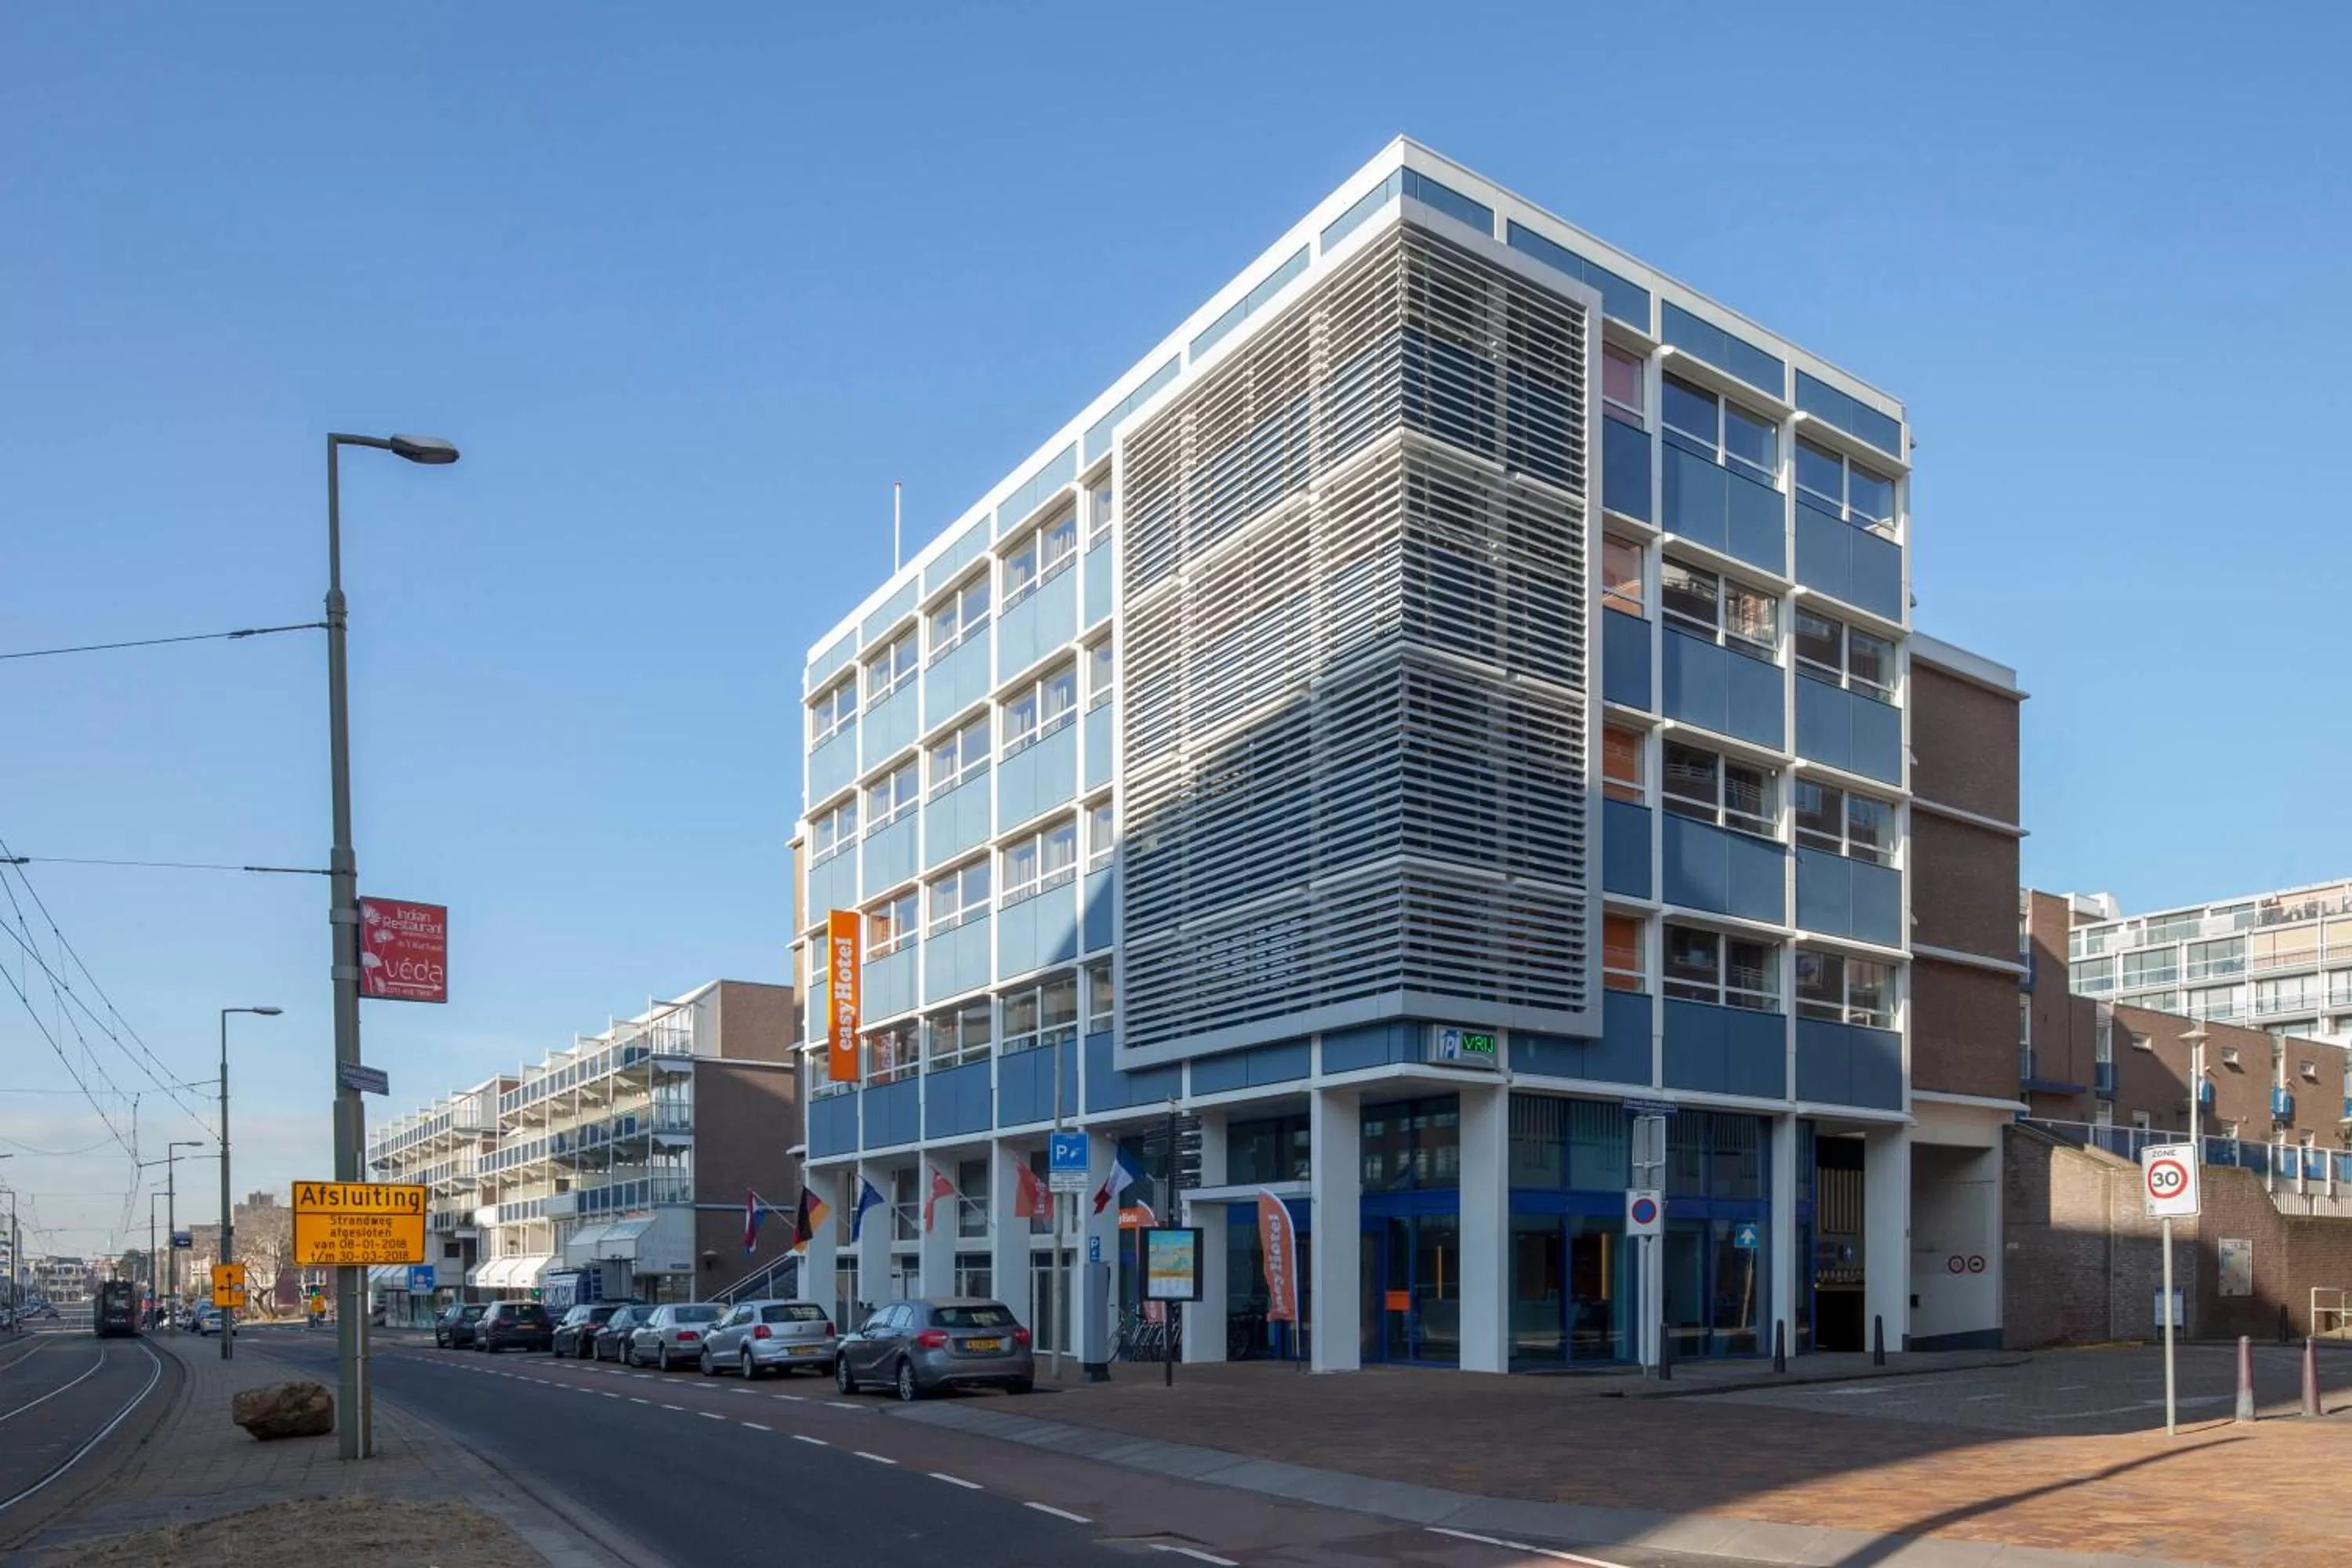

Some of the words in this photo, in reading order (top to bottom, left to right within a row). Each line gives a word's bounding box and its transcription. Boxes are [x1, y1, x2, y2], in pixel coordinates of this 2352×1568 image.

[397, 906, 430, 923] Indian
[383, 916, 443, 934] Restaurant
[385, 957, 443, 982] véda
[834, 937, 855, 1051] easyHotel
[1464, 1035, 1494, 1054] VRIJ
[1056, 1144, 1068, 1161] P
[2152, 1149, 2177, 1158] ZONE
[2152, 1171, 2180, 1188] 30
[300, 1185, 419, 1212] Afsluiting
[329, 1215, 394, 1227] Strandweg
[329, 1227, 392, 1239] afgesloten
[314, 1240, 336, 1250] van
[339, 1239, 407, 1250] 08-01-2018
[310, 1251, 336, 1263] t/m
[339, 1250, 409, 1261] 30-03-2018
